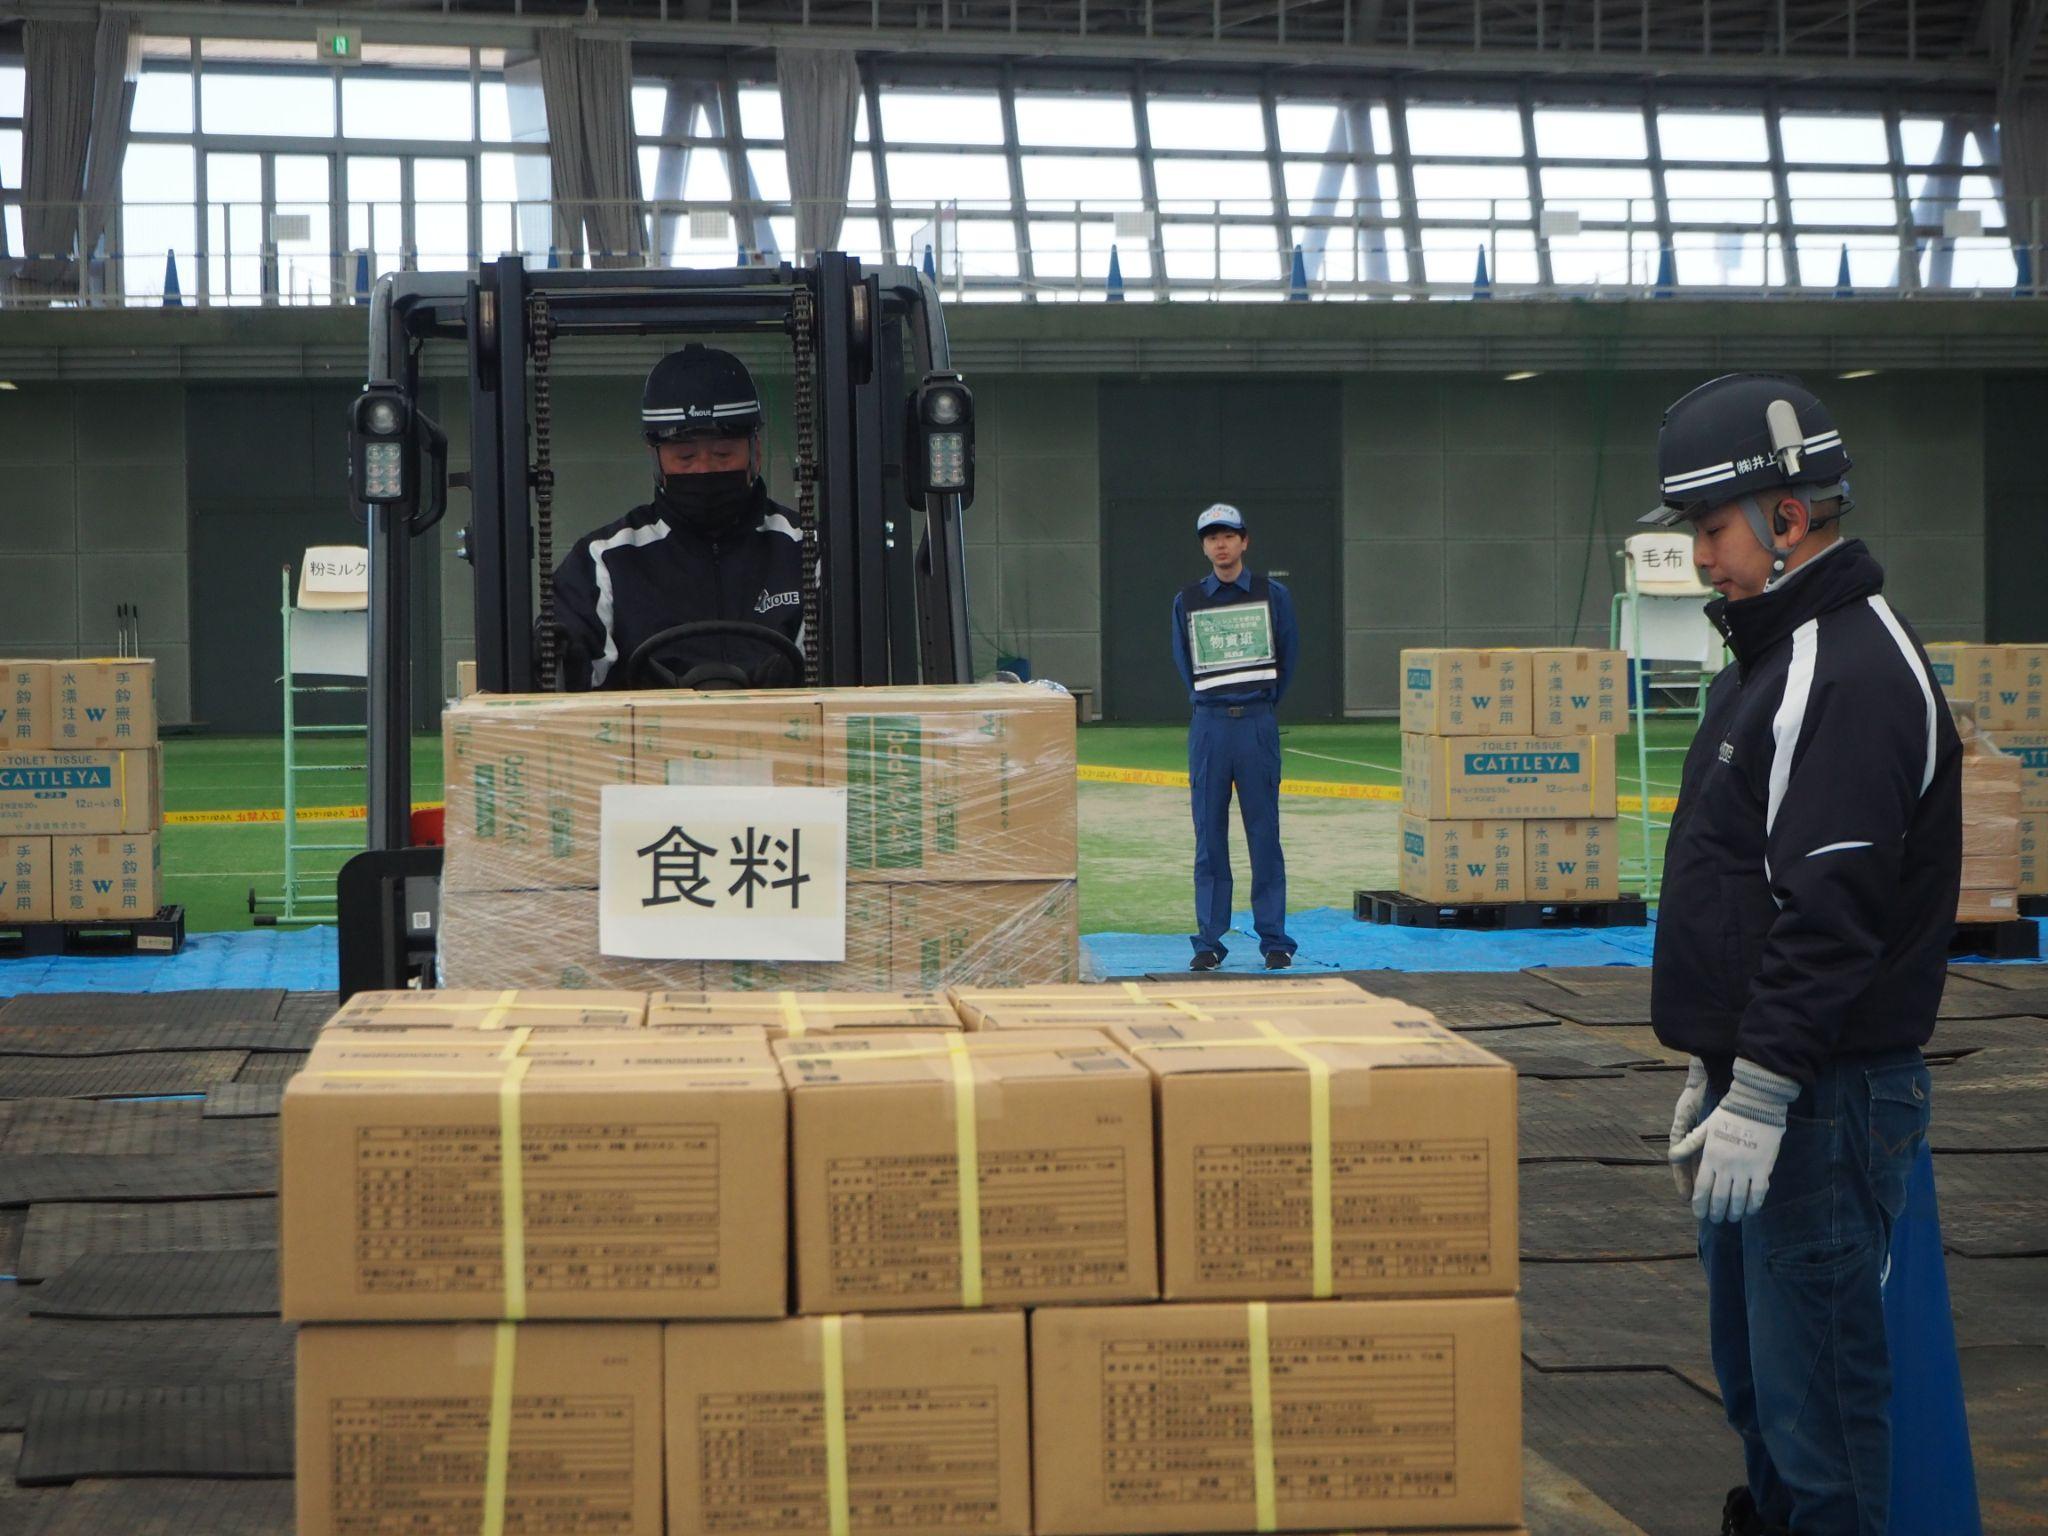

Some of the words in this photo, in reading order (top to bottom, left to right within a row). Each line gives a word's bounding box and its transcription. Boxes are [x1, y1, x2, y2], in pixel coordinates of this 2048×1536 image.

[1640, 548, 1684, 569] 毛布
[310, 561, 367, 577] 粉ミルク
[1472, 696, 1491, 709] W
[1570, 696, 1590, 709] W
[1999, 691, 2019, 705] W
[85, 708, 107, 722] W
[1482, 741, 1518, 751] TOILET
[1525, 741, 1563, 750] TISSUE
[7, 755, 46, 766] TOILET
[53, 755, 92, 765] TISSUE
[1472, 756, 1571, 771] CATTLEYA
[0, 771, 102, 787] CATTLEYA
[637, 825, 811, 909] 食料
[1466, 864, 1486, 877] W
[1556, 861, 1577, 875] W
[92, 880, 113, 894] W
